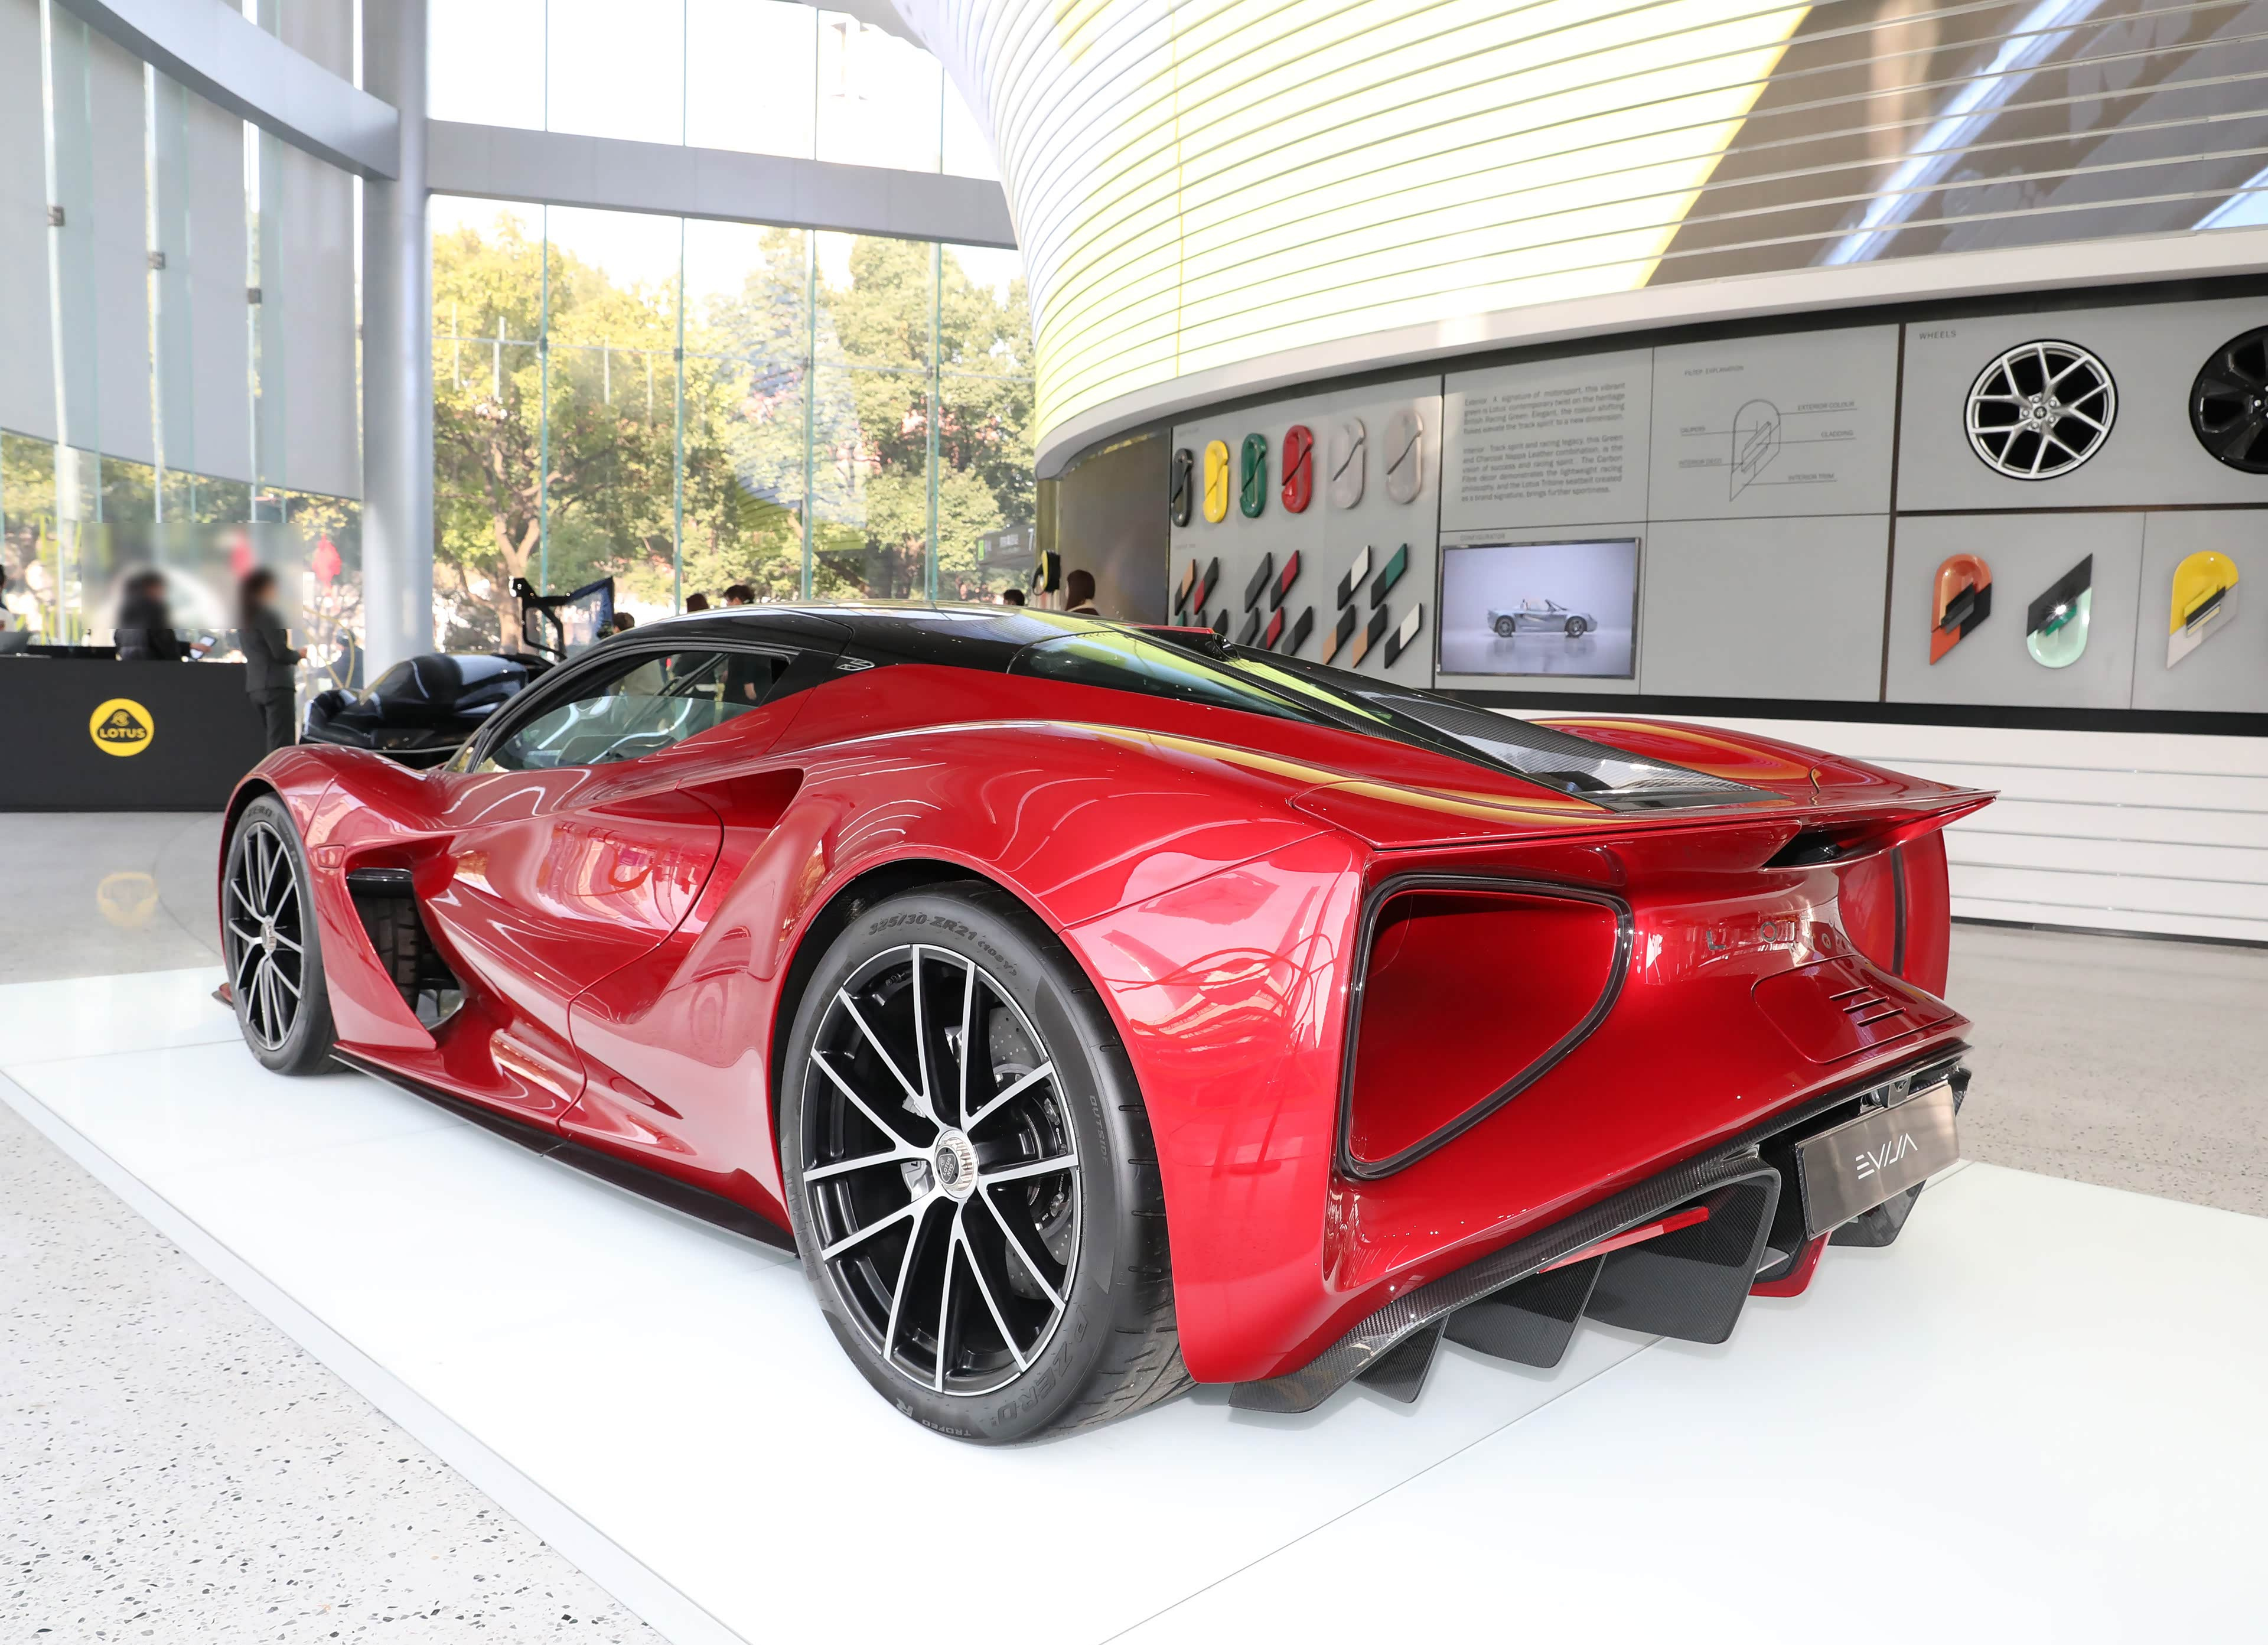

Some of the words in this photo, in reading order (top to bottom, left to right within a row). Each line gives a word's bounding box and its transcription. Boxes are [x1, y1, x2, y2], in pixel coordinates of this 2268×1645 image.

[1919, 330, 1956, 340] WHEELS
[99, 727, 146, 738] LOTUS
[869, 914, 927, 936] 325/30
[930, 916, 977, 941] ZR21
[1089, 1095, 1109, 1167] OUTSIDE
[1855, 1132, 1918, 1180] EVIJA
[942, 1156, 951, 1176] LOTUS
[896, 1398, 914, 1417] R
[922, 1419, 972, 1436] TROFEO
